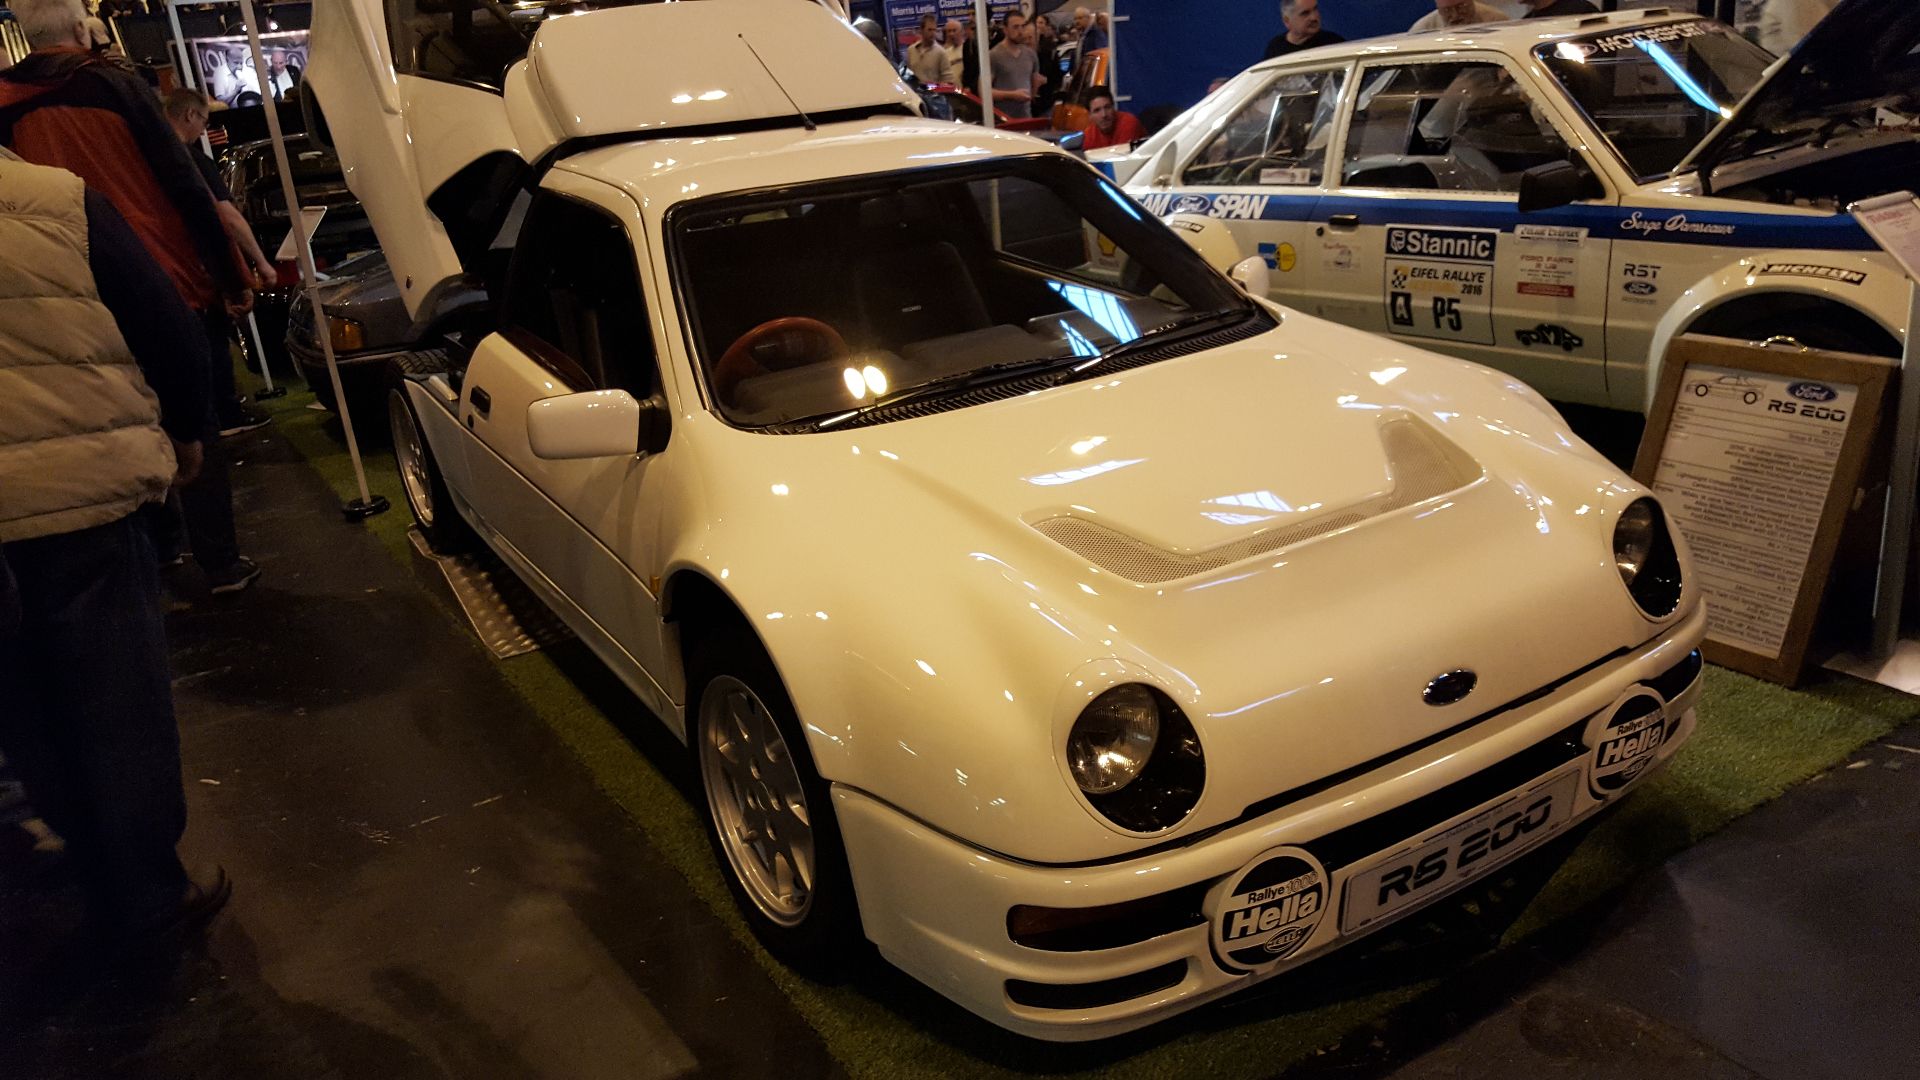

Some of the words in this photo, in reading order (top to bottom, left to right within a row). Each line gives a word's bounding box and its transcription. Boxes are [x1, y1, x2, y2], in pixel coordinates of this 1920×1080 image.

[1597, 24, 1706, 53] MOTORSPORT
[1208, 194, 1270, 219] SPAN
[1620, 211, 1662, 236] Serge
[1406, 230, 1491, 258] Stannic
[1410, 267, 1440, 280] EIFEL
[1443, 270, 1486, 283] RALLYE
[1623, 263, 1662, 279] RST
[1767, 264, 1864, 283] MICHELIN
[1460, 284, 1483, 296] 2016
[1433, 296, 1463, 331] P5
[1794, 383, 1829, 401] Ford
[1768, 399, 1797, 414] RS
[1800, 404, 1847, 423] 200
[1617, 720, 1643, 735] Rallye
[1601, 726, 1662, 766] Hella
[1378, 847, 1449, 906] RS
[1457, 795, 1553, 869] 200
[1248, 885, 1285, 904] Rallye
[1286, 870, 1318, 895] 1000
[1229, 890, 1319, 939] Hella
